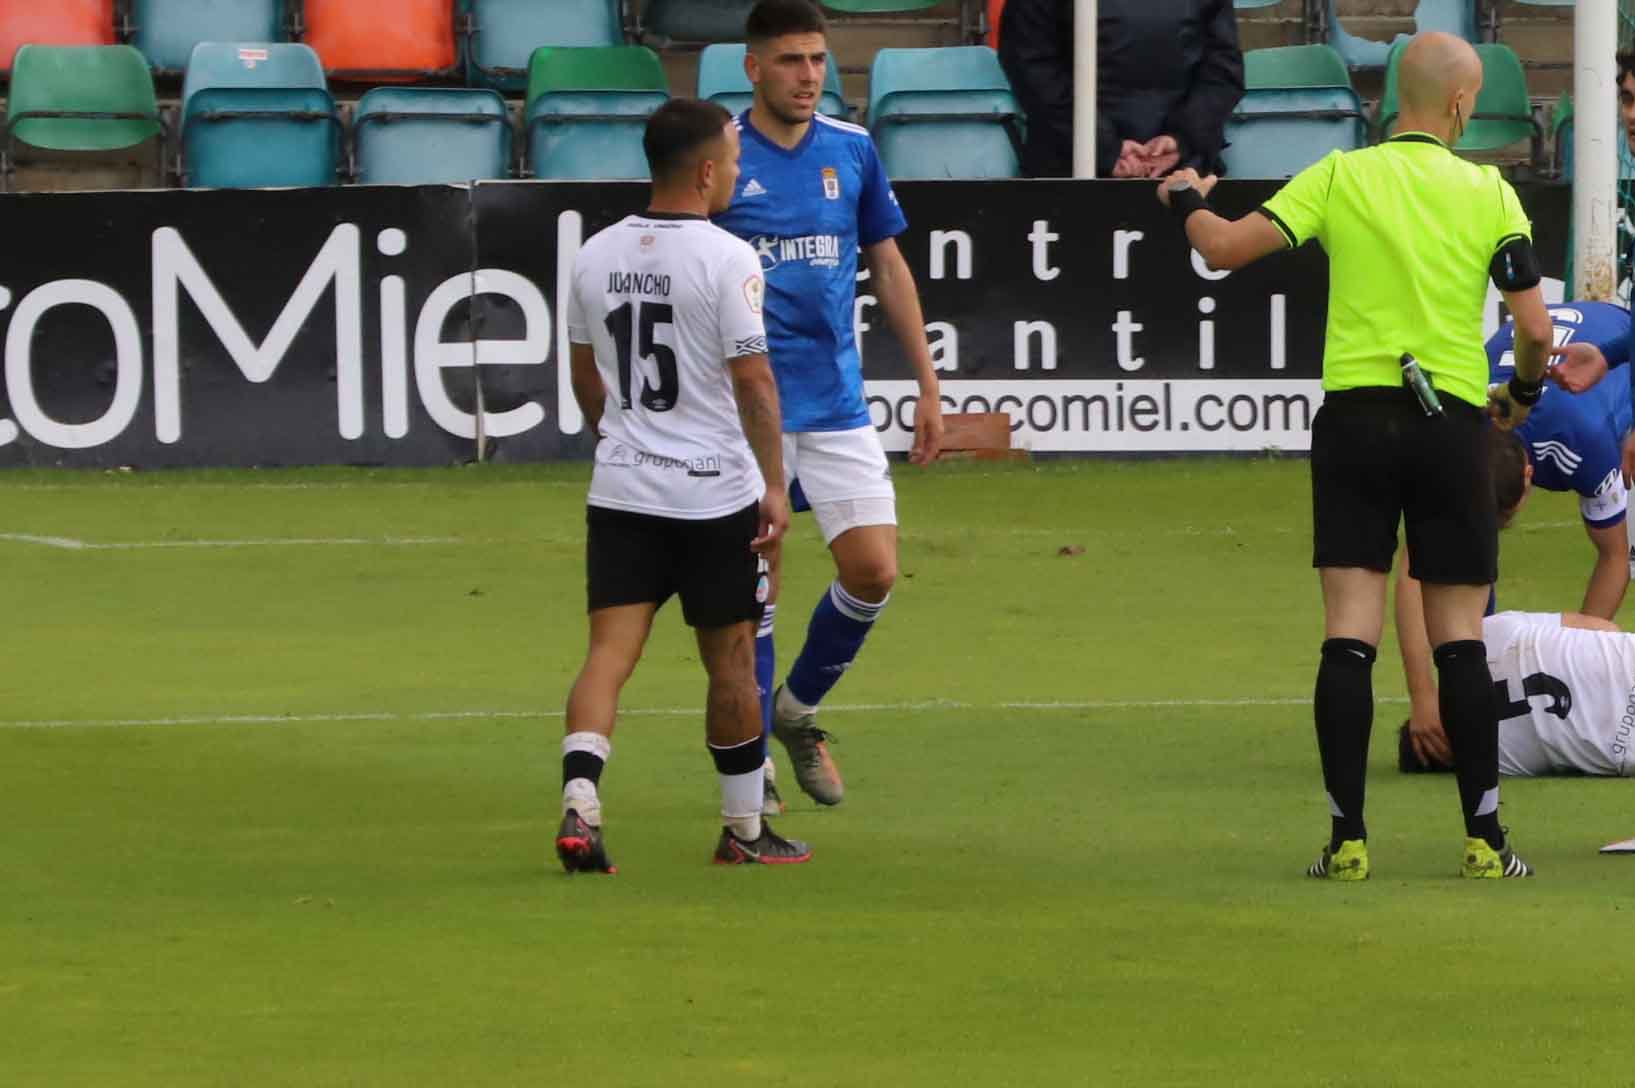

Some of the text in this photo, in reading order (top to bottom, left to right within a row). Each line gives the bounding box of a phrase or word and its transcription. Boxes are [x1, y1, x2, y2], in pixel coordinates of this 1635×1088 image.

[780, 235, 839, 261] INTEGRA
[607, 271, 672, 297] JUANCHO
[0, 209, 583, 449] oMiel
[604, 300, 679, 412] 15
